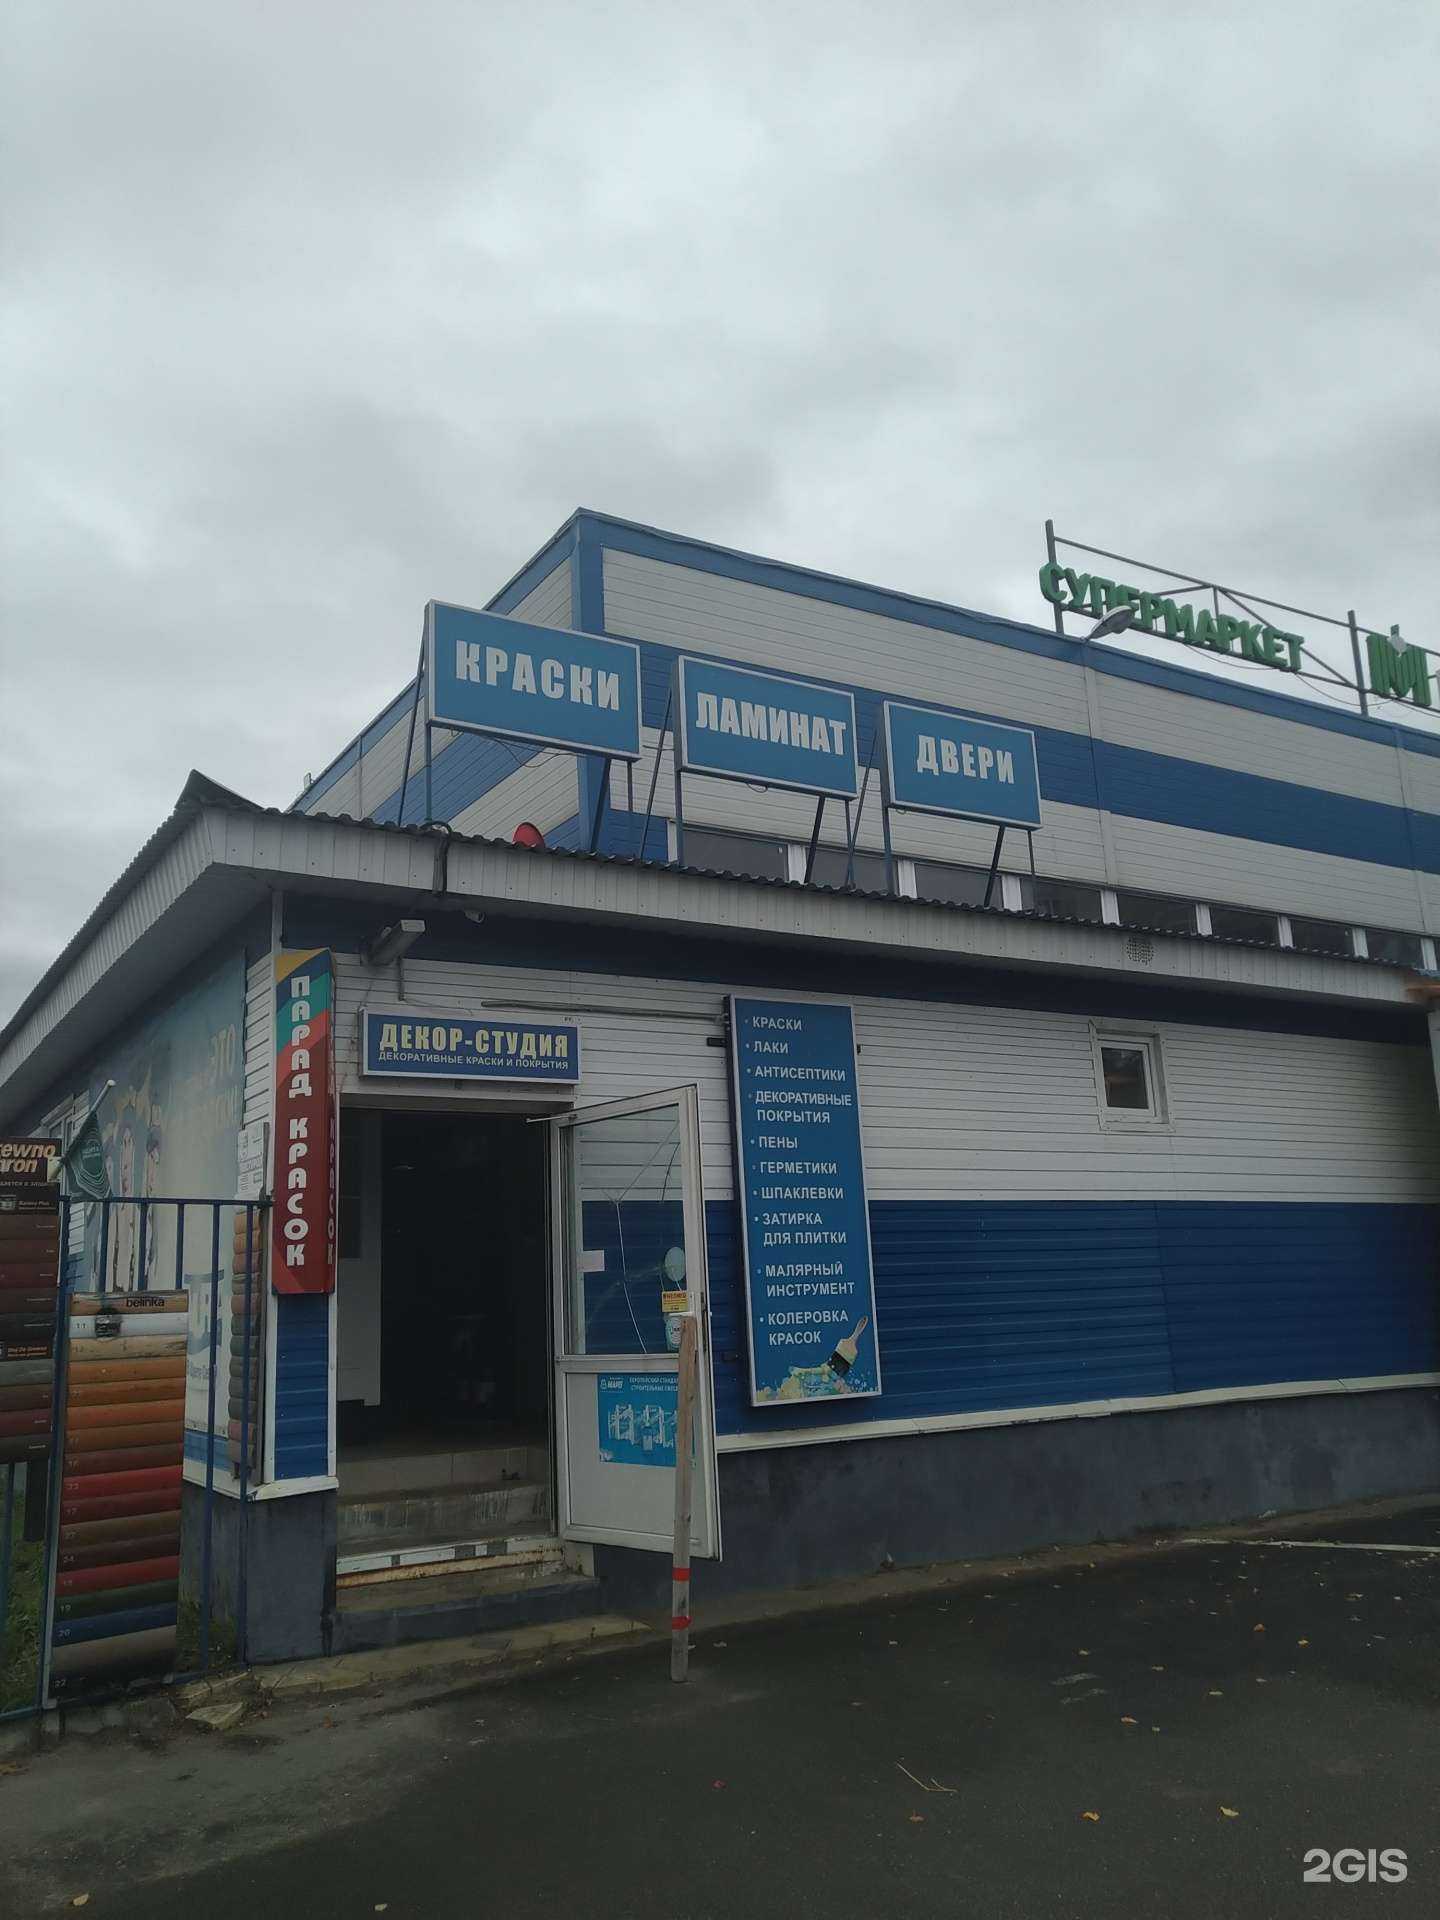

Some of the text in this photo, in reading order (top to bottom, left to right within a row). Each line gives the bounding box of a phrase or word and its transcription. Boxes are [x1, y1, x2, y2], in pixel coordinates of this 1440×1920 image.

[1038, 562, 1305, 672] СУПЕРМАРКЕТ
[456, 641, 620, 711] КРАСКИ
[696, 692, 847, 756] ЛАМИНАТ
[916, 734, 1015, 785] ДВЕРИ
[752, 1016, 802, 1031] КРАСКИ
[379, 1023, 568, 1060] ДЕКОР-СТУДИЯ
[753, 1041, 789, 1054] ЛАКИ
[378, 1052, 464, 1065] ДЕКОРАТИВНЫЕ
[466, 1056, 504, 1067] КРАСКИ
[515, 1059, 569, 1070] ПОКРЫТИЯ
[754, 1066, 846, 1081] АНТИСЕПТИКИ
[755, 1090, 852, 1106] ДЕКОРАТИВНЫЕ
[283, 975, 313, 1267] ПАРАД КРАСОК
[757, 1109, 830, 1123] ПОКРЫТИЯ
[0, 1143, 56, 1158] ewno
[759, 1136, 798, 1149] ПЕНЫ
[760, 1161, 838, 1175] ГЕРМЕТИКИ
[761, 1186, 844, 1200] ШПАКЛЕВКИ
[762, 1212, 823, 1226] ЗАТИРКА
[763, 1231, 847, 1248] ДЛЯ ПЛИТКИ
[765, 1260, 844, 1278] МАЛЯРНЫЙ
[766, 1281, 856, 1298] ИНСТРУМЕНТ
[126, 1296, 165, 1308] belinka
[767, 1309, 849, 1326] КОЛЕРОВКА
[768, 1330, 823, 1347] КРАСОК
